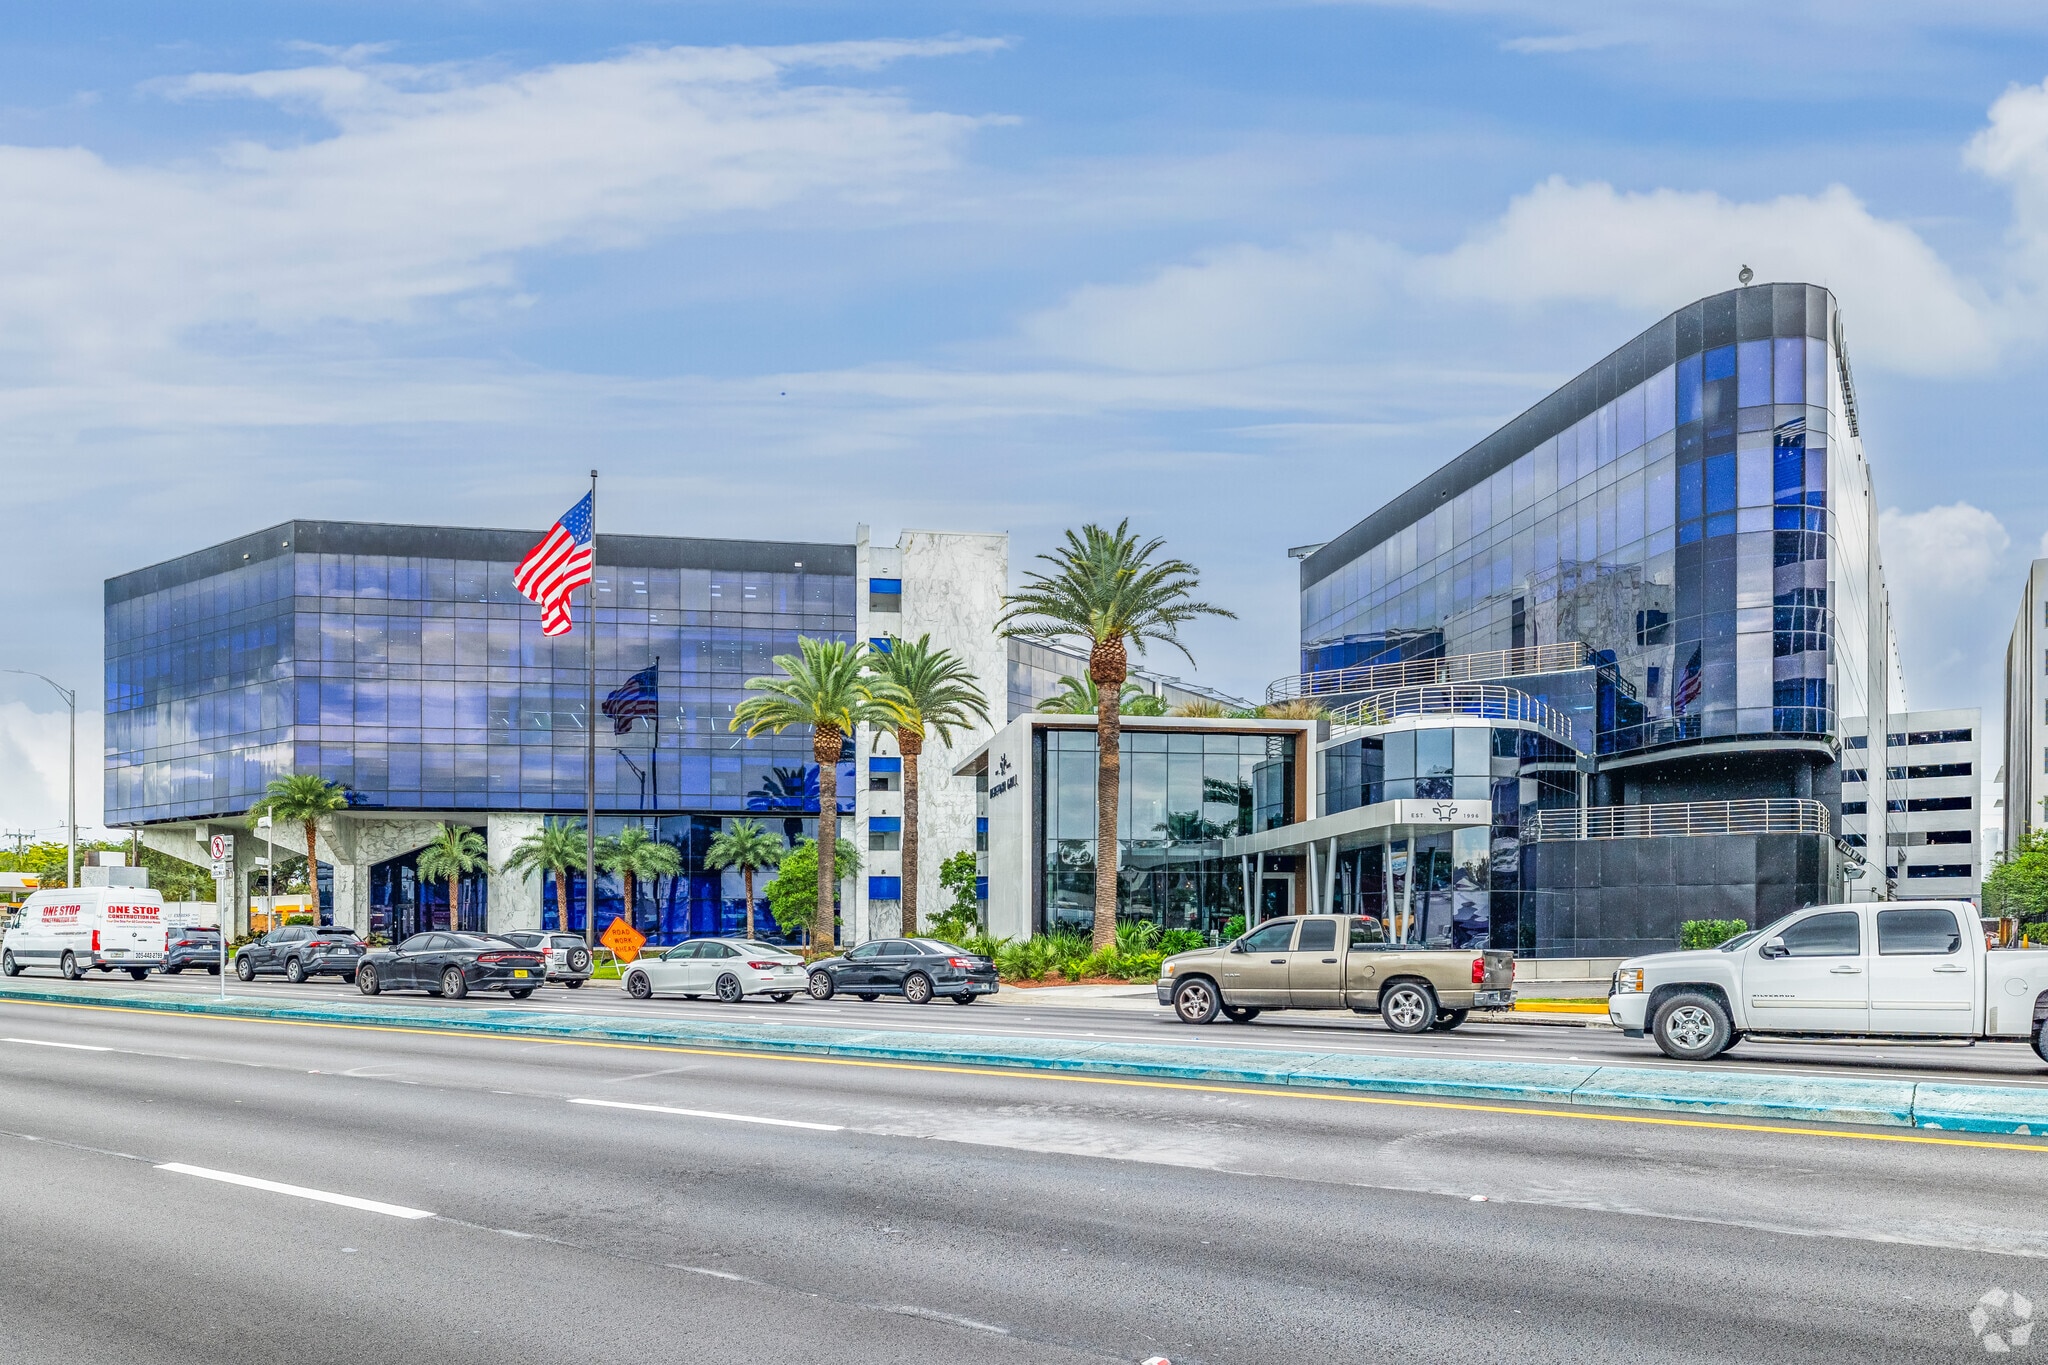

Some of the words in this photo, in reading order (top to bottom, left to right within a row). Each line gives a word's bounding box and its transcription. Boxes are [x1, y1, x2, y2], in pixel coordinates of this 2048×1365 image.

[43, 906, 58, 916] ONE
[59, 904, 81, 916] STOP
[107, 905, 130, 914] ONE
[132, 906, 160, 915] STOP
